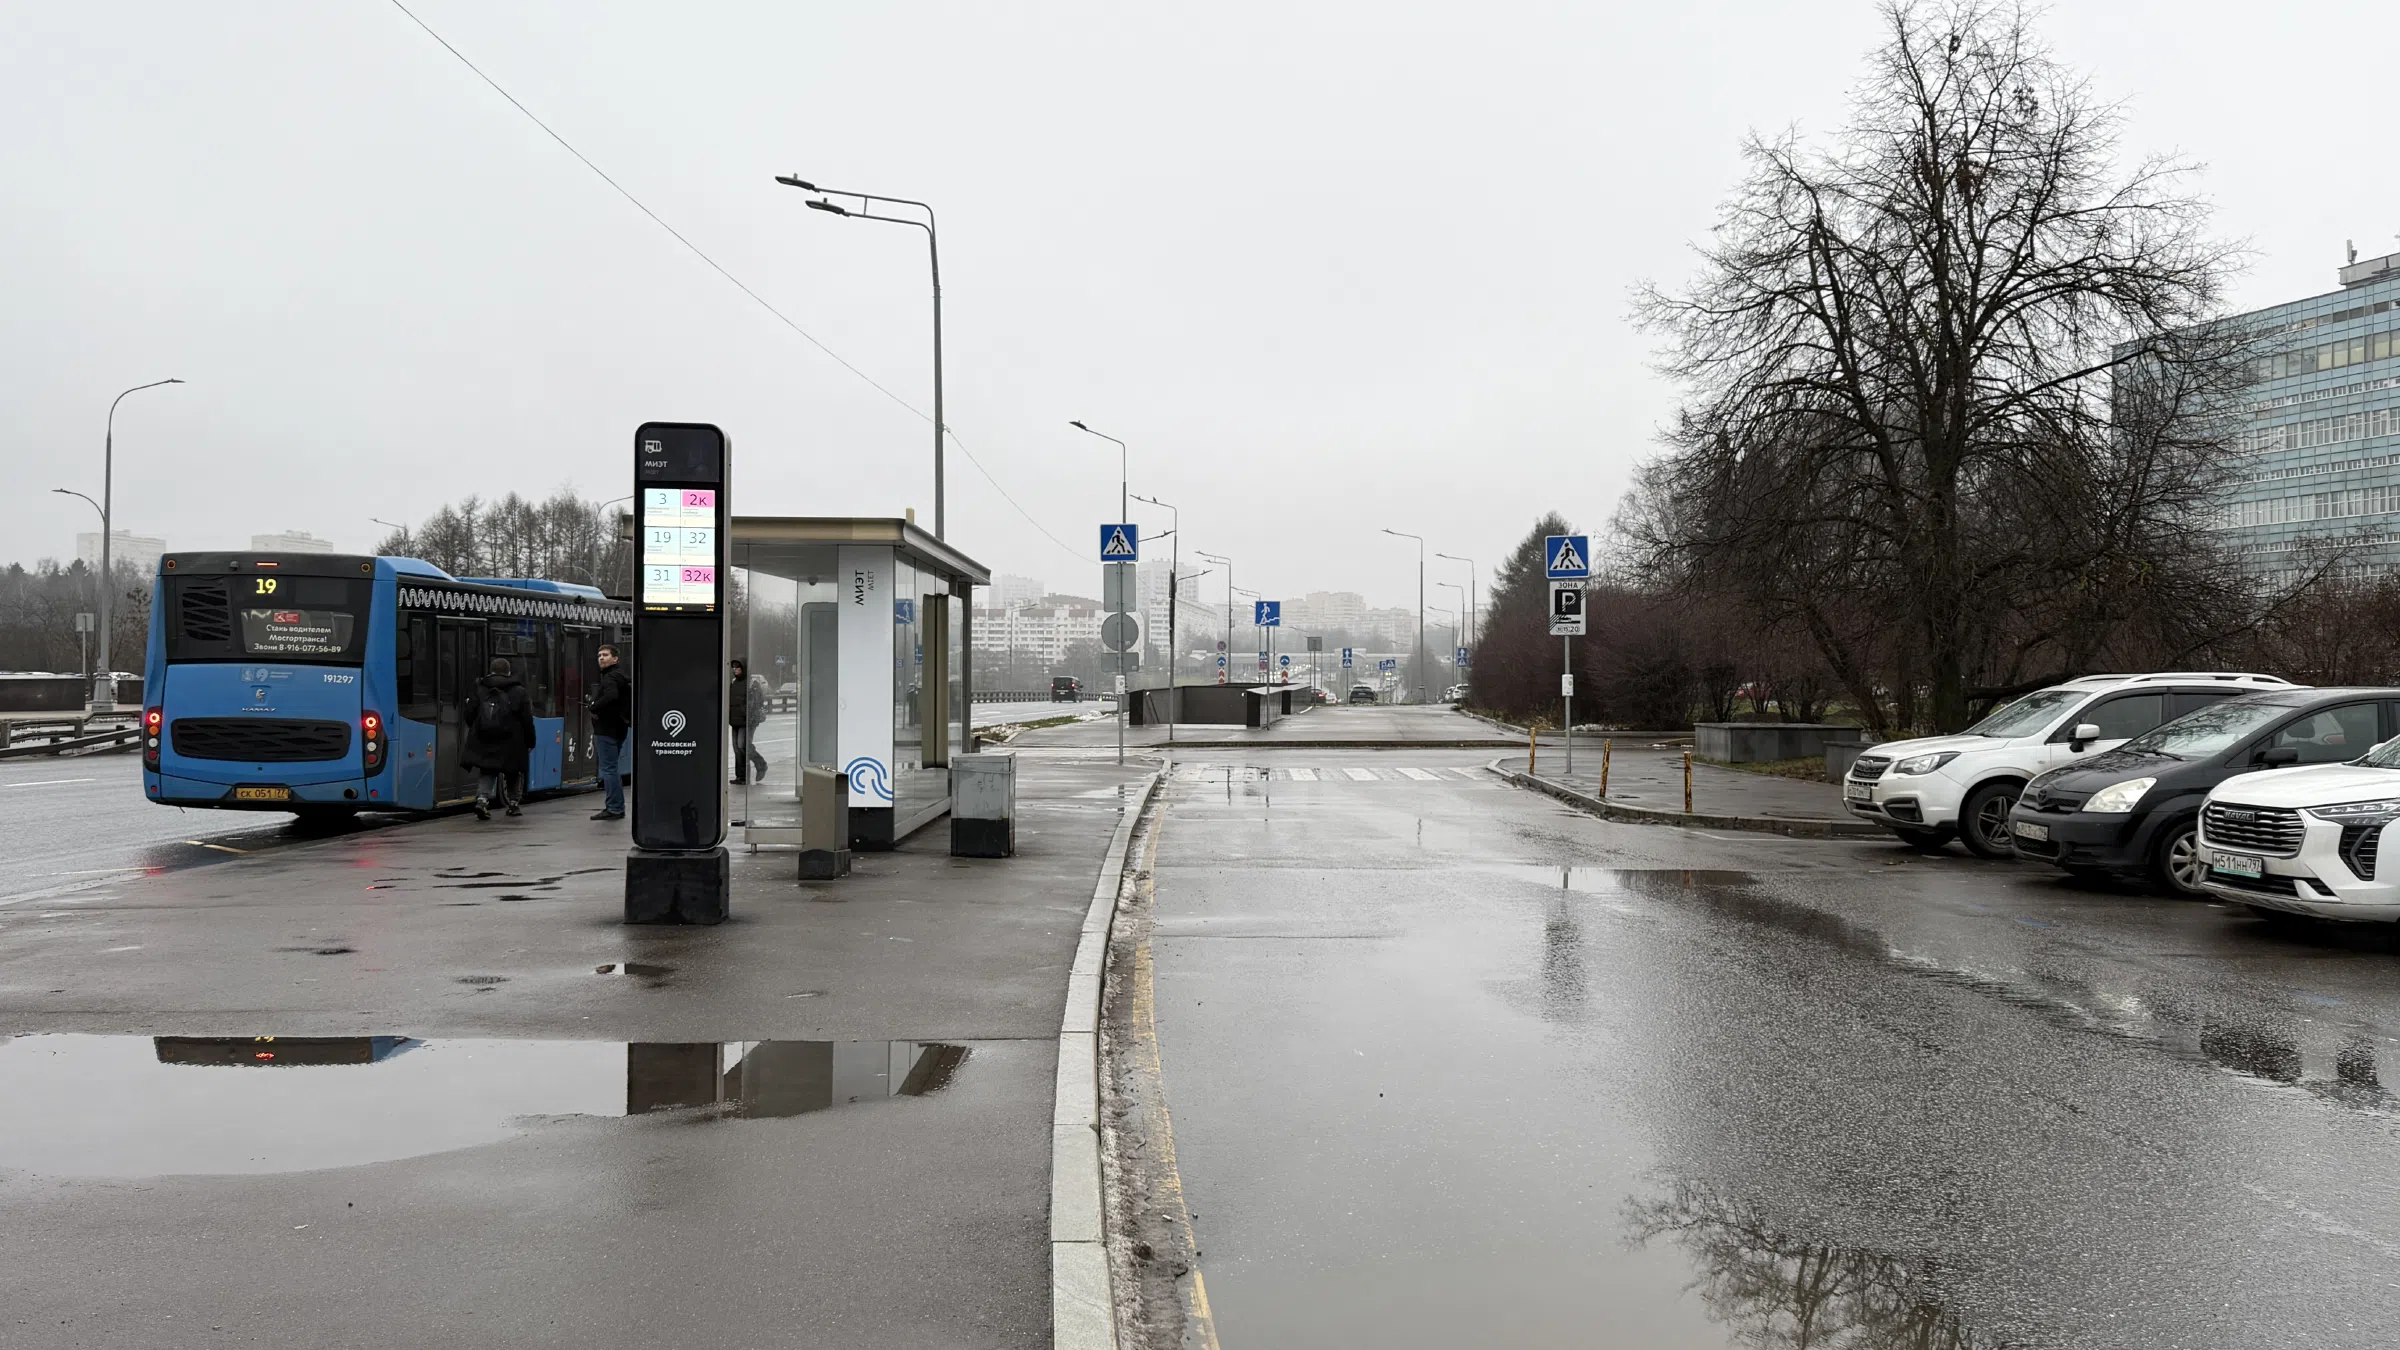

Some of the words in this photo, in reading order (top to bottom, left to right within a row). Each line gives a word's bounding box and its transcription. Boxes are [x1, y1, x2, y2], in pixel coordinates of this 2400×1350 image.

[645, 460, 668, 468] МИЭТ
[659, 493, 667, 505] 3
[654, 531, 671, 543] 19
[689, 532, 706, 544] 32
[653, 569, 671, 582] 31
[256, 578, 277, 594] 19
[855, 569, 864, 606] МИЭТ
[266, 624, 288, 632] Стань
[289, 625, 332, 633] водителем
[269, 634, 327, 643] Мосгортранса!
[254, 643, 278, 651] Звони
[279, 643, 342, 653] 8-916-077-56-89
[323, 674, 354, 684] 191297
[2225, 811, 2252, 820] HAVAL
